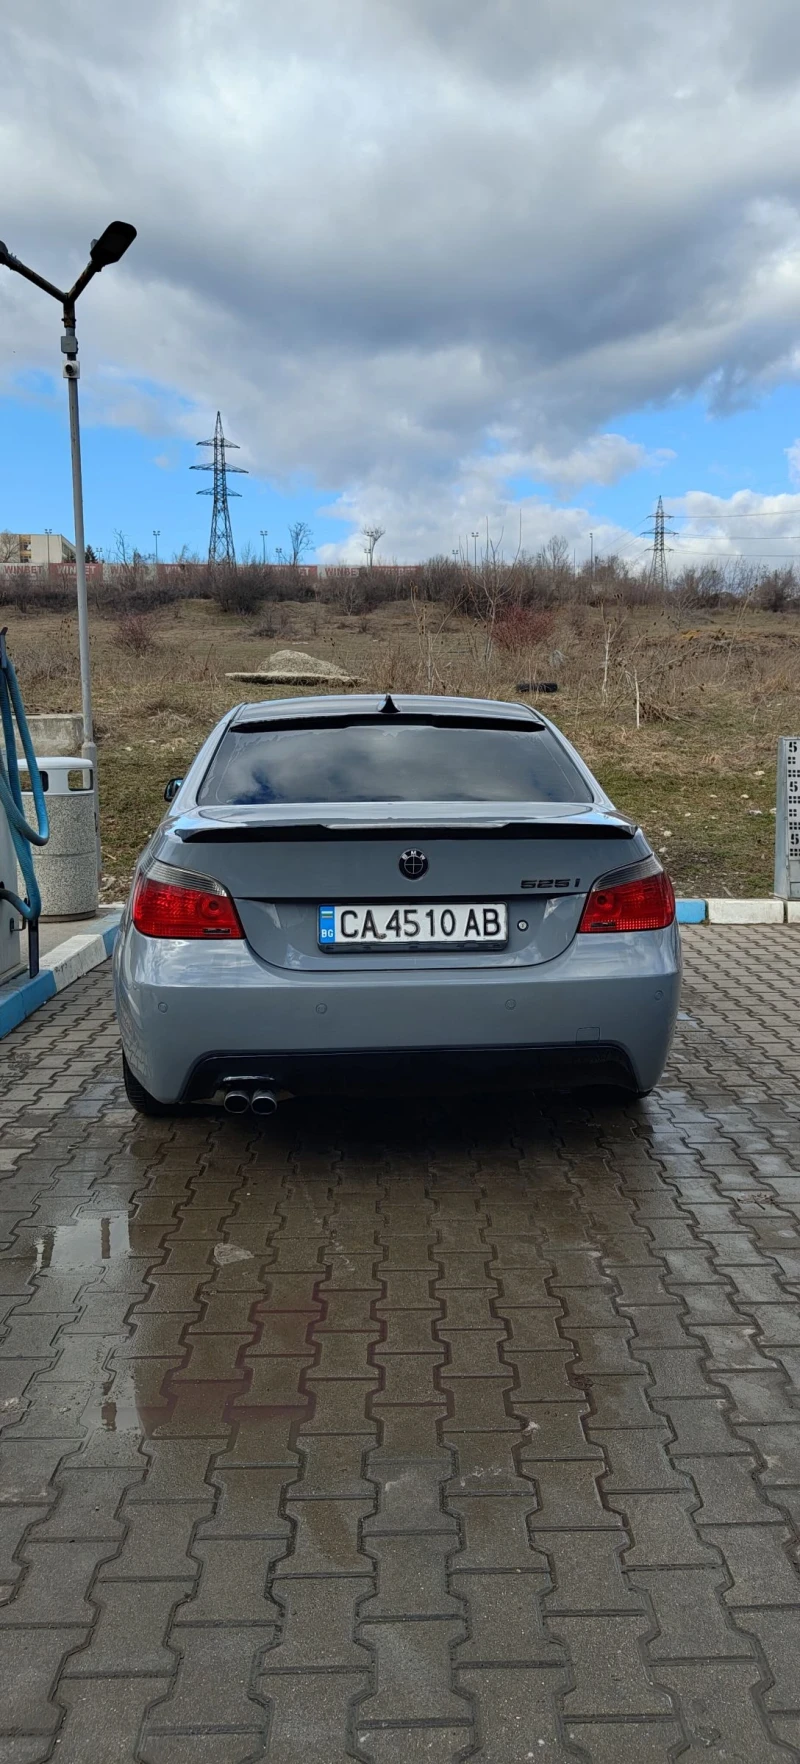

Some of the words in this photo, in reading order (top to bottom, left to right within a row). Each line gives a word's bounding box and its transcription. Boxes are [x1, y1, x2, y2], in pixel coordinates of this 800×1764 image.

[4, 565, 43, 574] WINBET
[57, 565, 97, 575] WINET
[340, 909, 379, 939] CA
[385, 908, 456, 938] 4510
[464, 908, 501, 937] AB
[321, 929, 334, 938] BG
